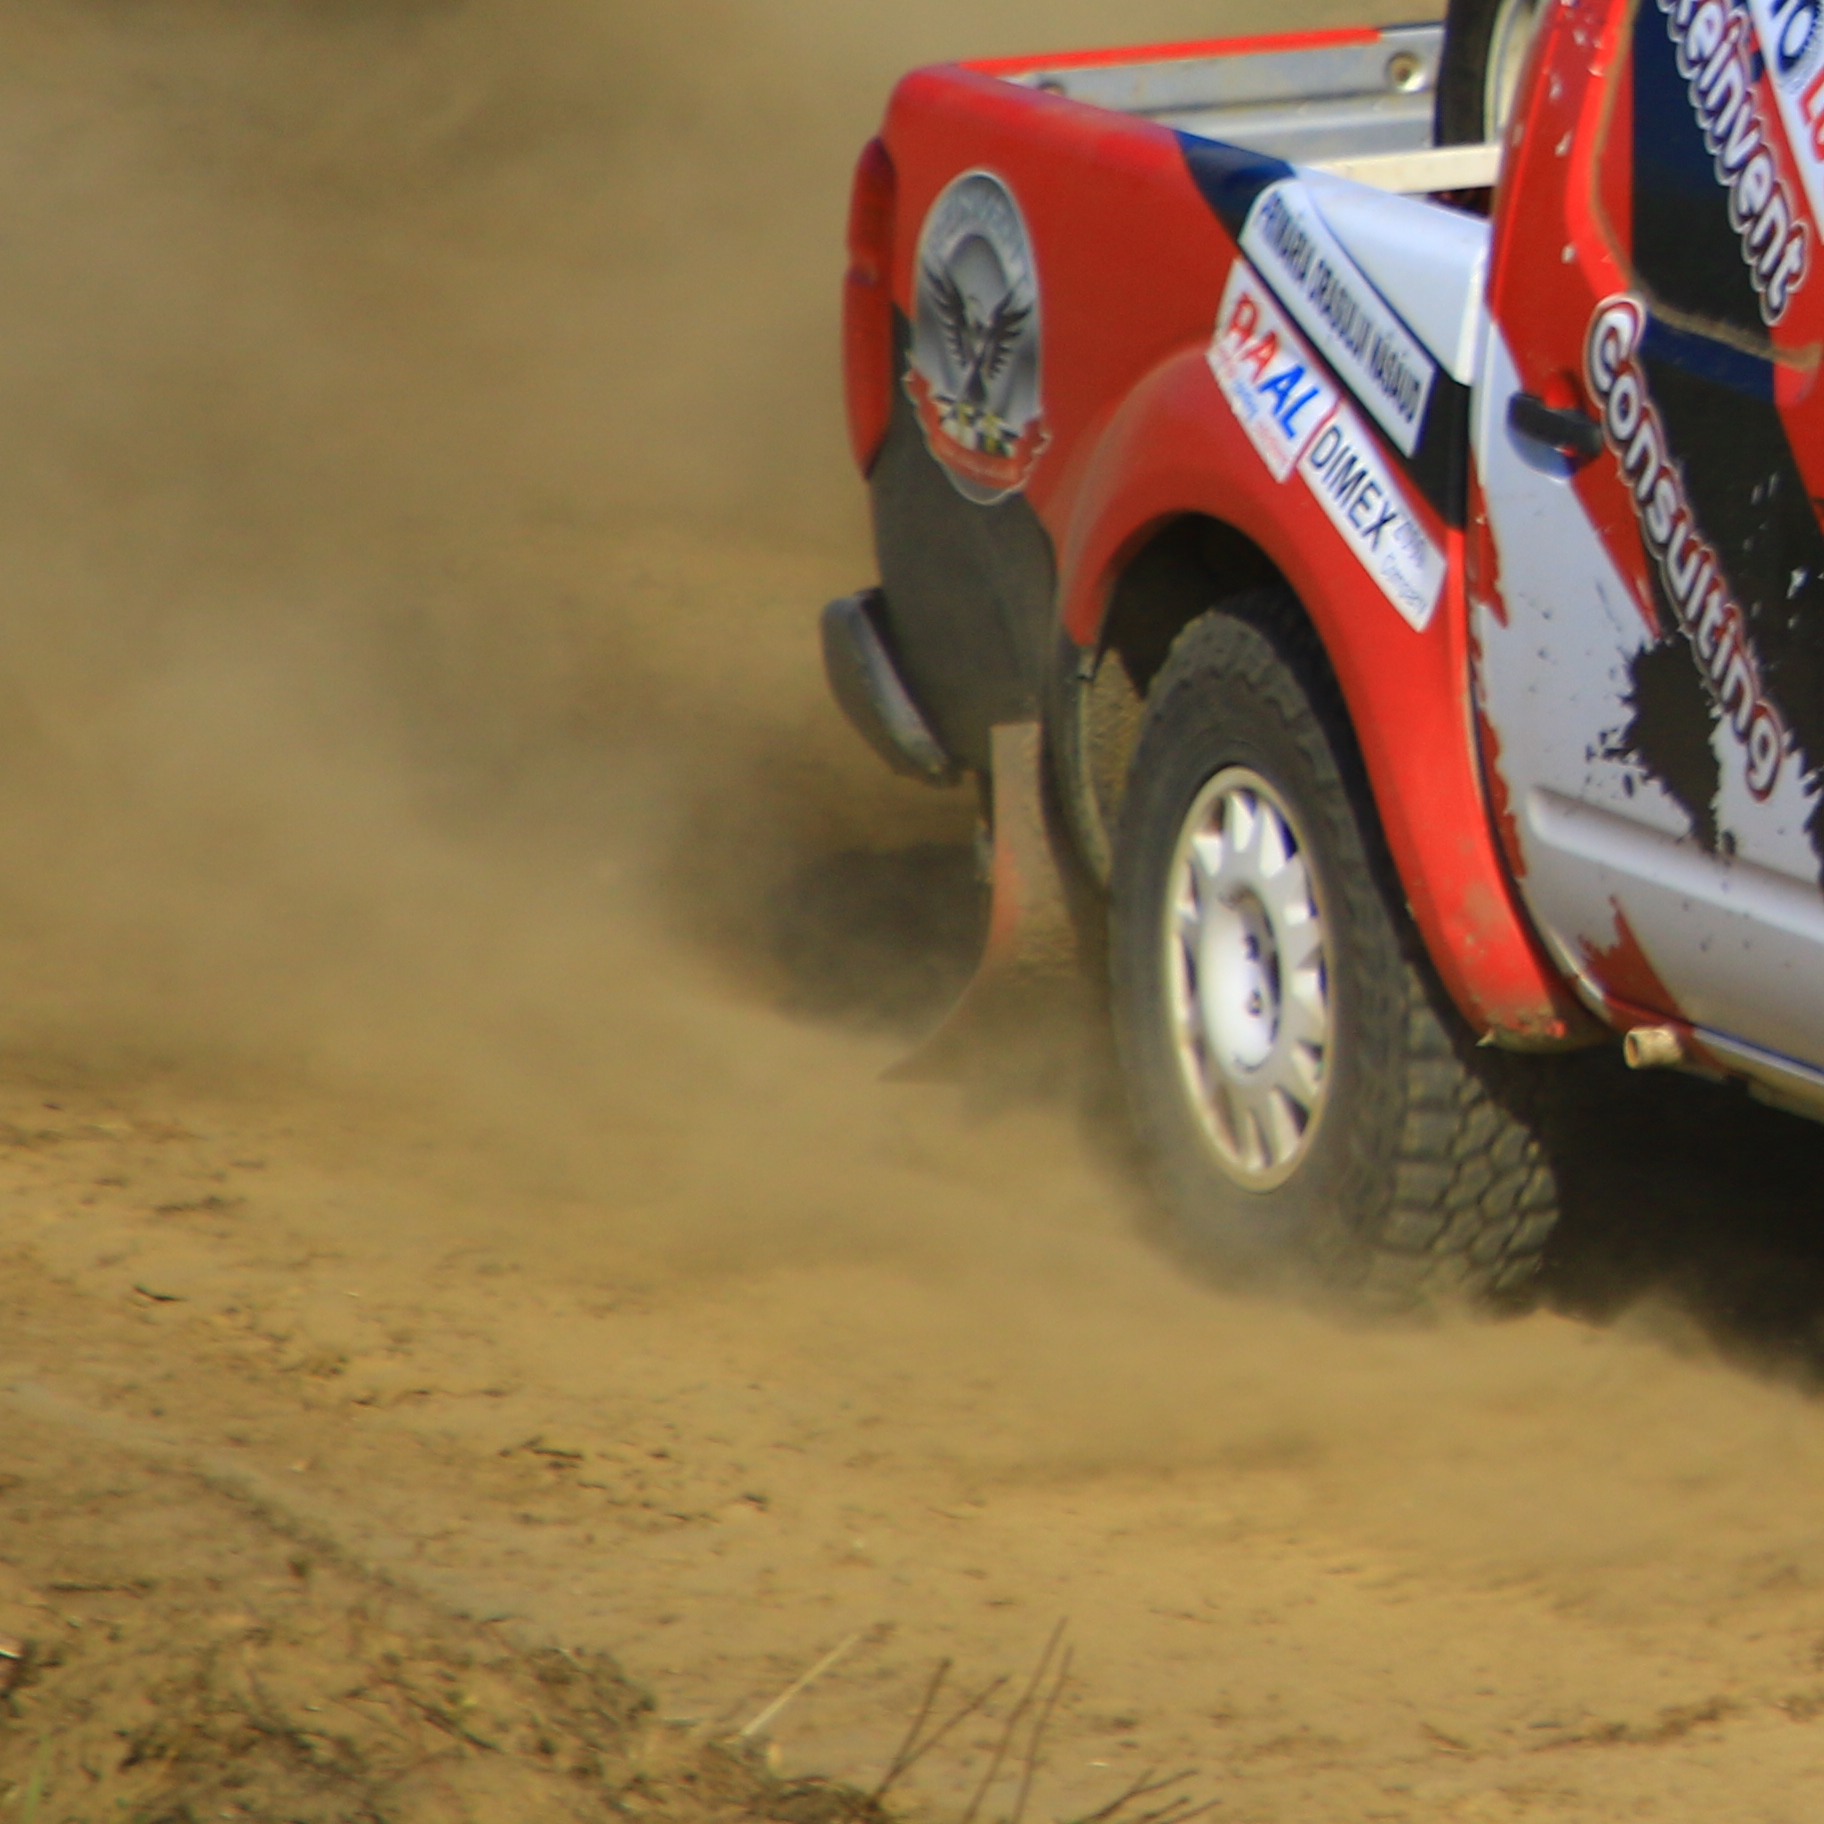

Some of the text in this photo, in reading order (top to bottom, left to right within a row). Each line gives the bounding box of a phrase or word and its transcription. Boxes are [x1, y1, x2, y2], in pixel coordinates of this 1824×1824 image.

[1226, 291, 1320, 440] RAAL
[1309, 426, 1397, 554] DIMEX
[1586, 297, 1781, 800] Consulting
